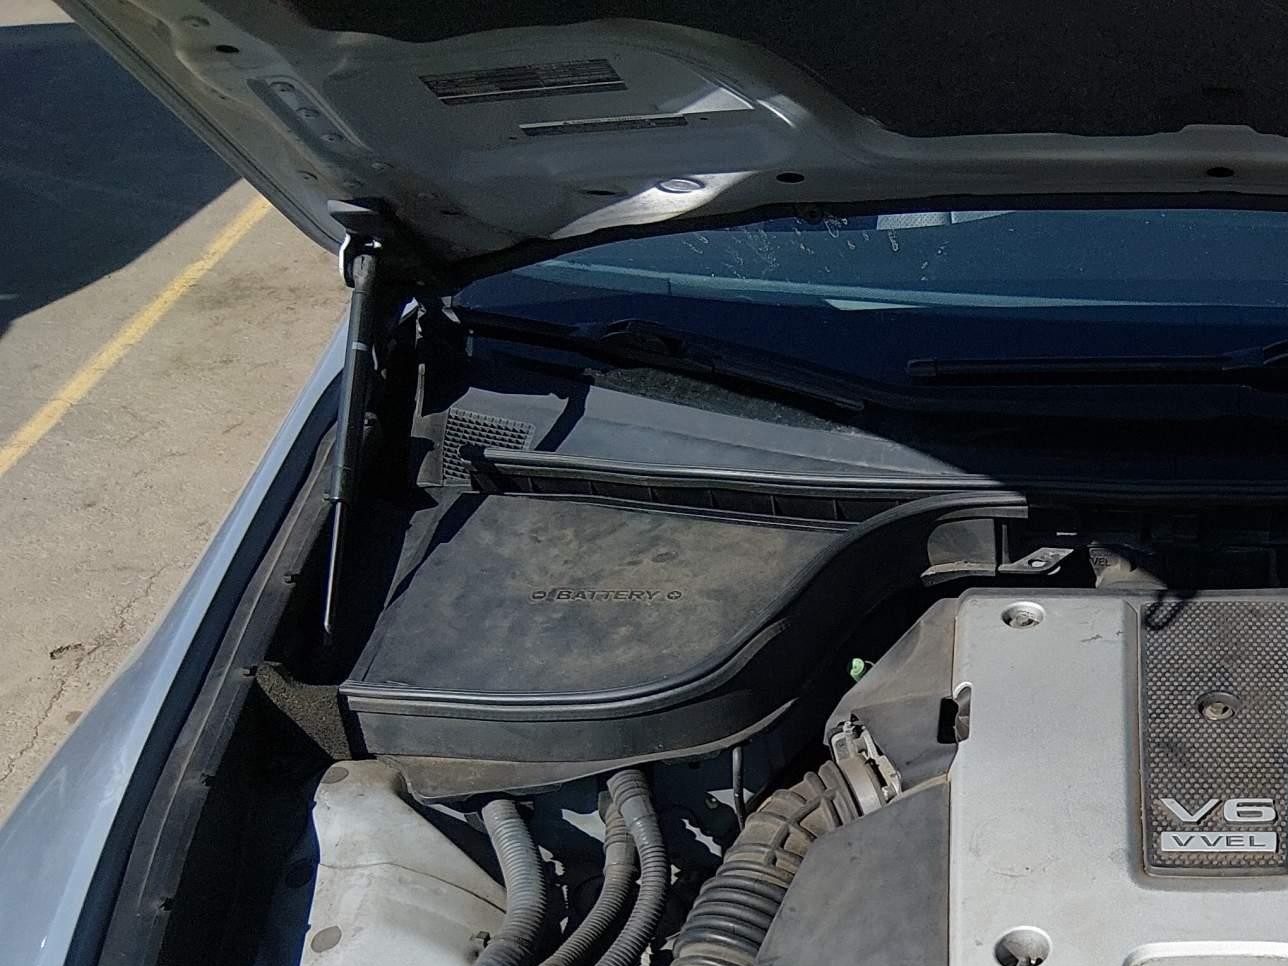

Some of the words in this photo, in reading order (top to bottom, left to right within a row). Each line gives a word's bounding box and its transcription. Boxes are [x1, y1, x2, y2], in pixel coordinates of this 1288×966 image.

[556, 590, 660, 600] BATTERY
[1160, 798, 1278, 822] V6
[1171, 835, 1267, 847] VVEL
